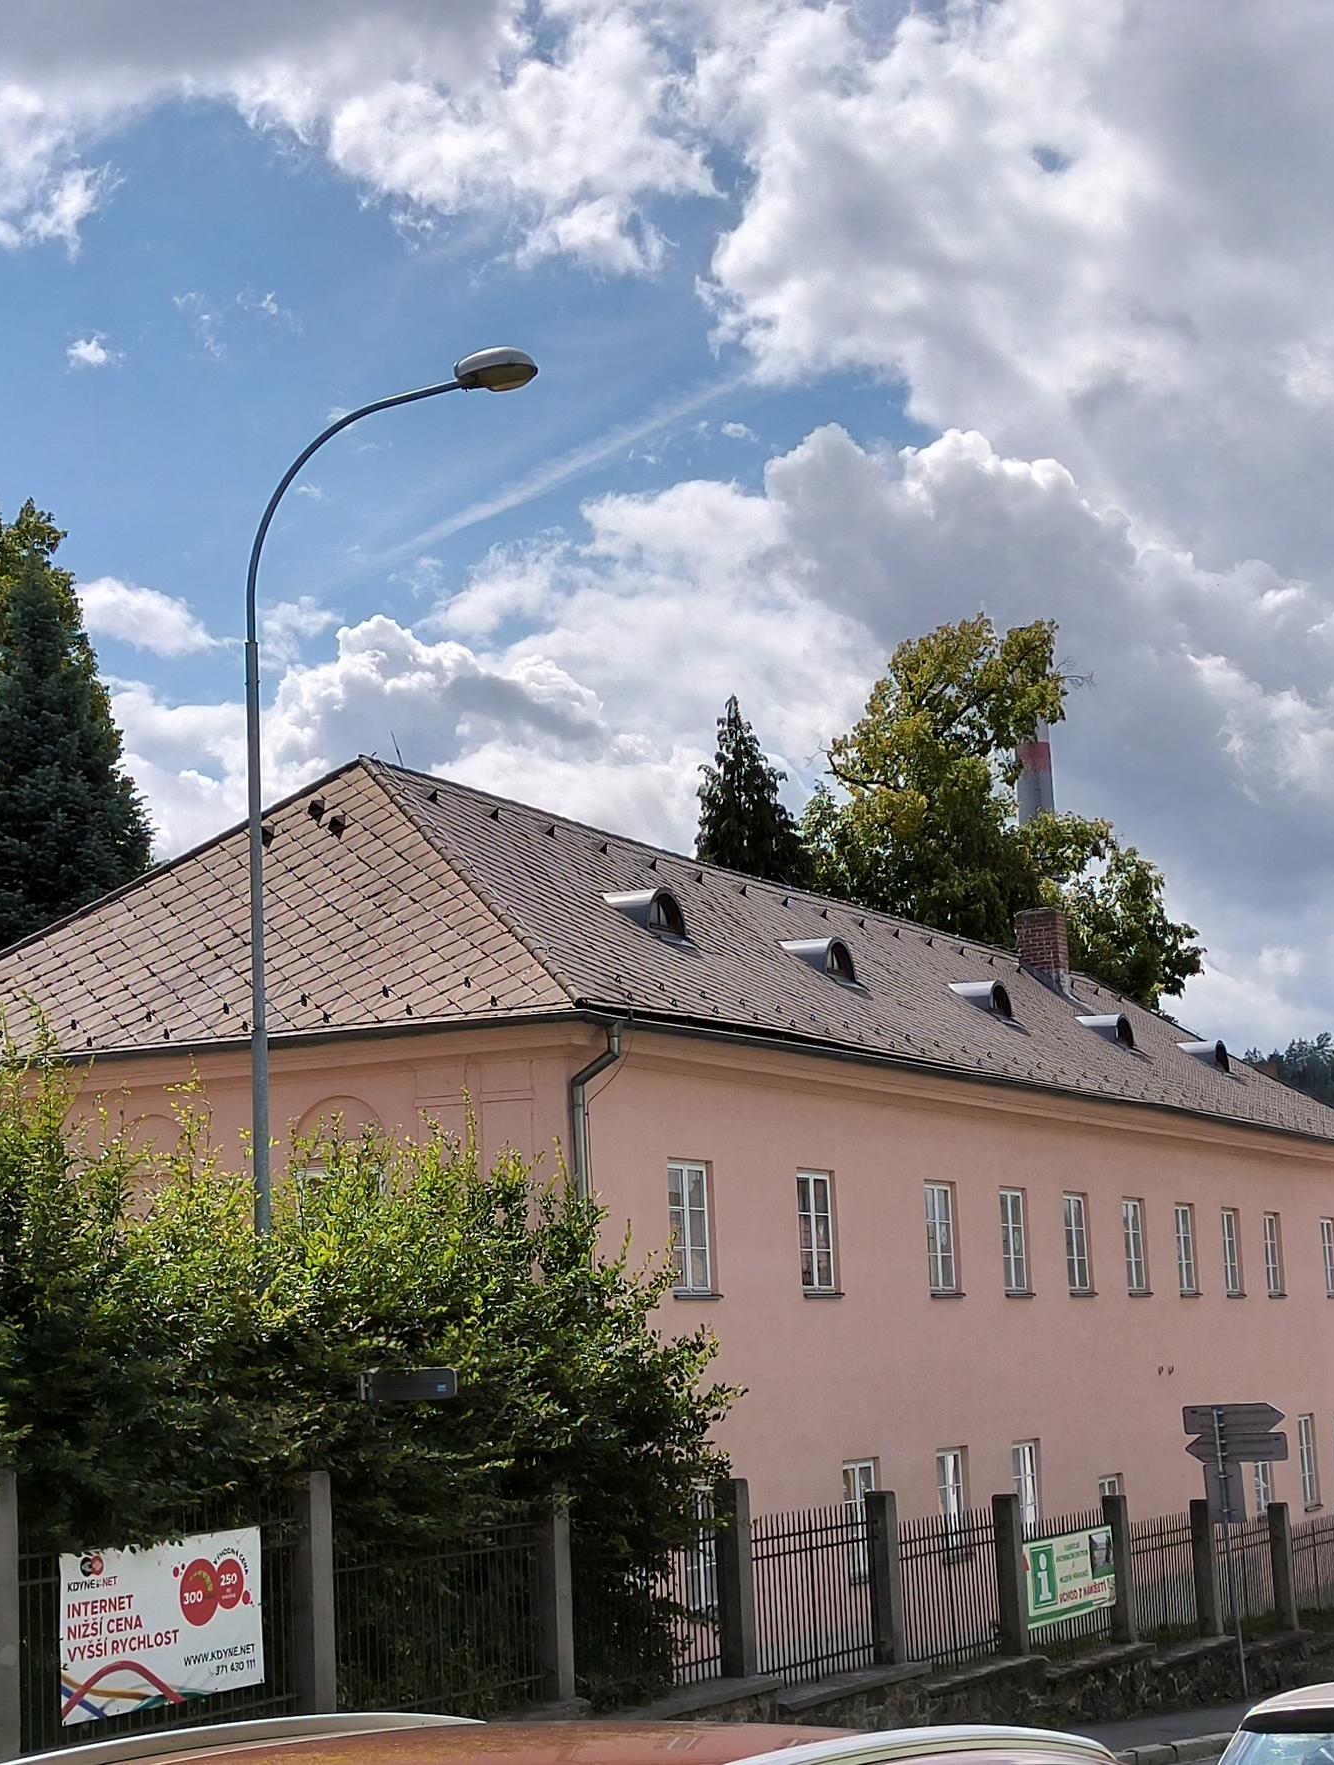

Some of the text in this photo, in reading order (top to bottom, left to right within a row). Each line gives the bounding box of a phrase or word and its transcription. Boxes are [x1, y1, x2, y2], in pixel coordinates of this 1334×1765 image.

[220, 1573, 238, 1587] 250
[67, 1594, 134, 1619] INTERNET
[183, 1590, 203, 1605] 300
[67, 1615, 143, 1642] NIŽŠÍ CENA
[67, 1629, 180, 1662] VYŠŠÍ RYCHLOST
[183, 1643, 255, 1667] WWW.KDYNE.NET
[215, 1658, 256, 1676] 371 430 111
